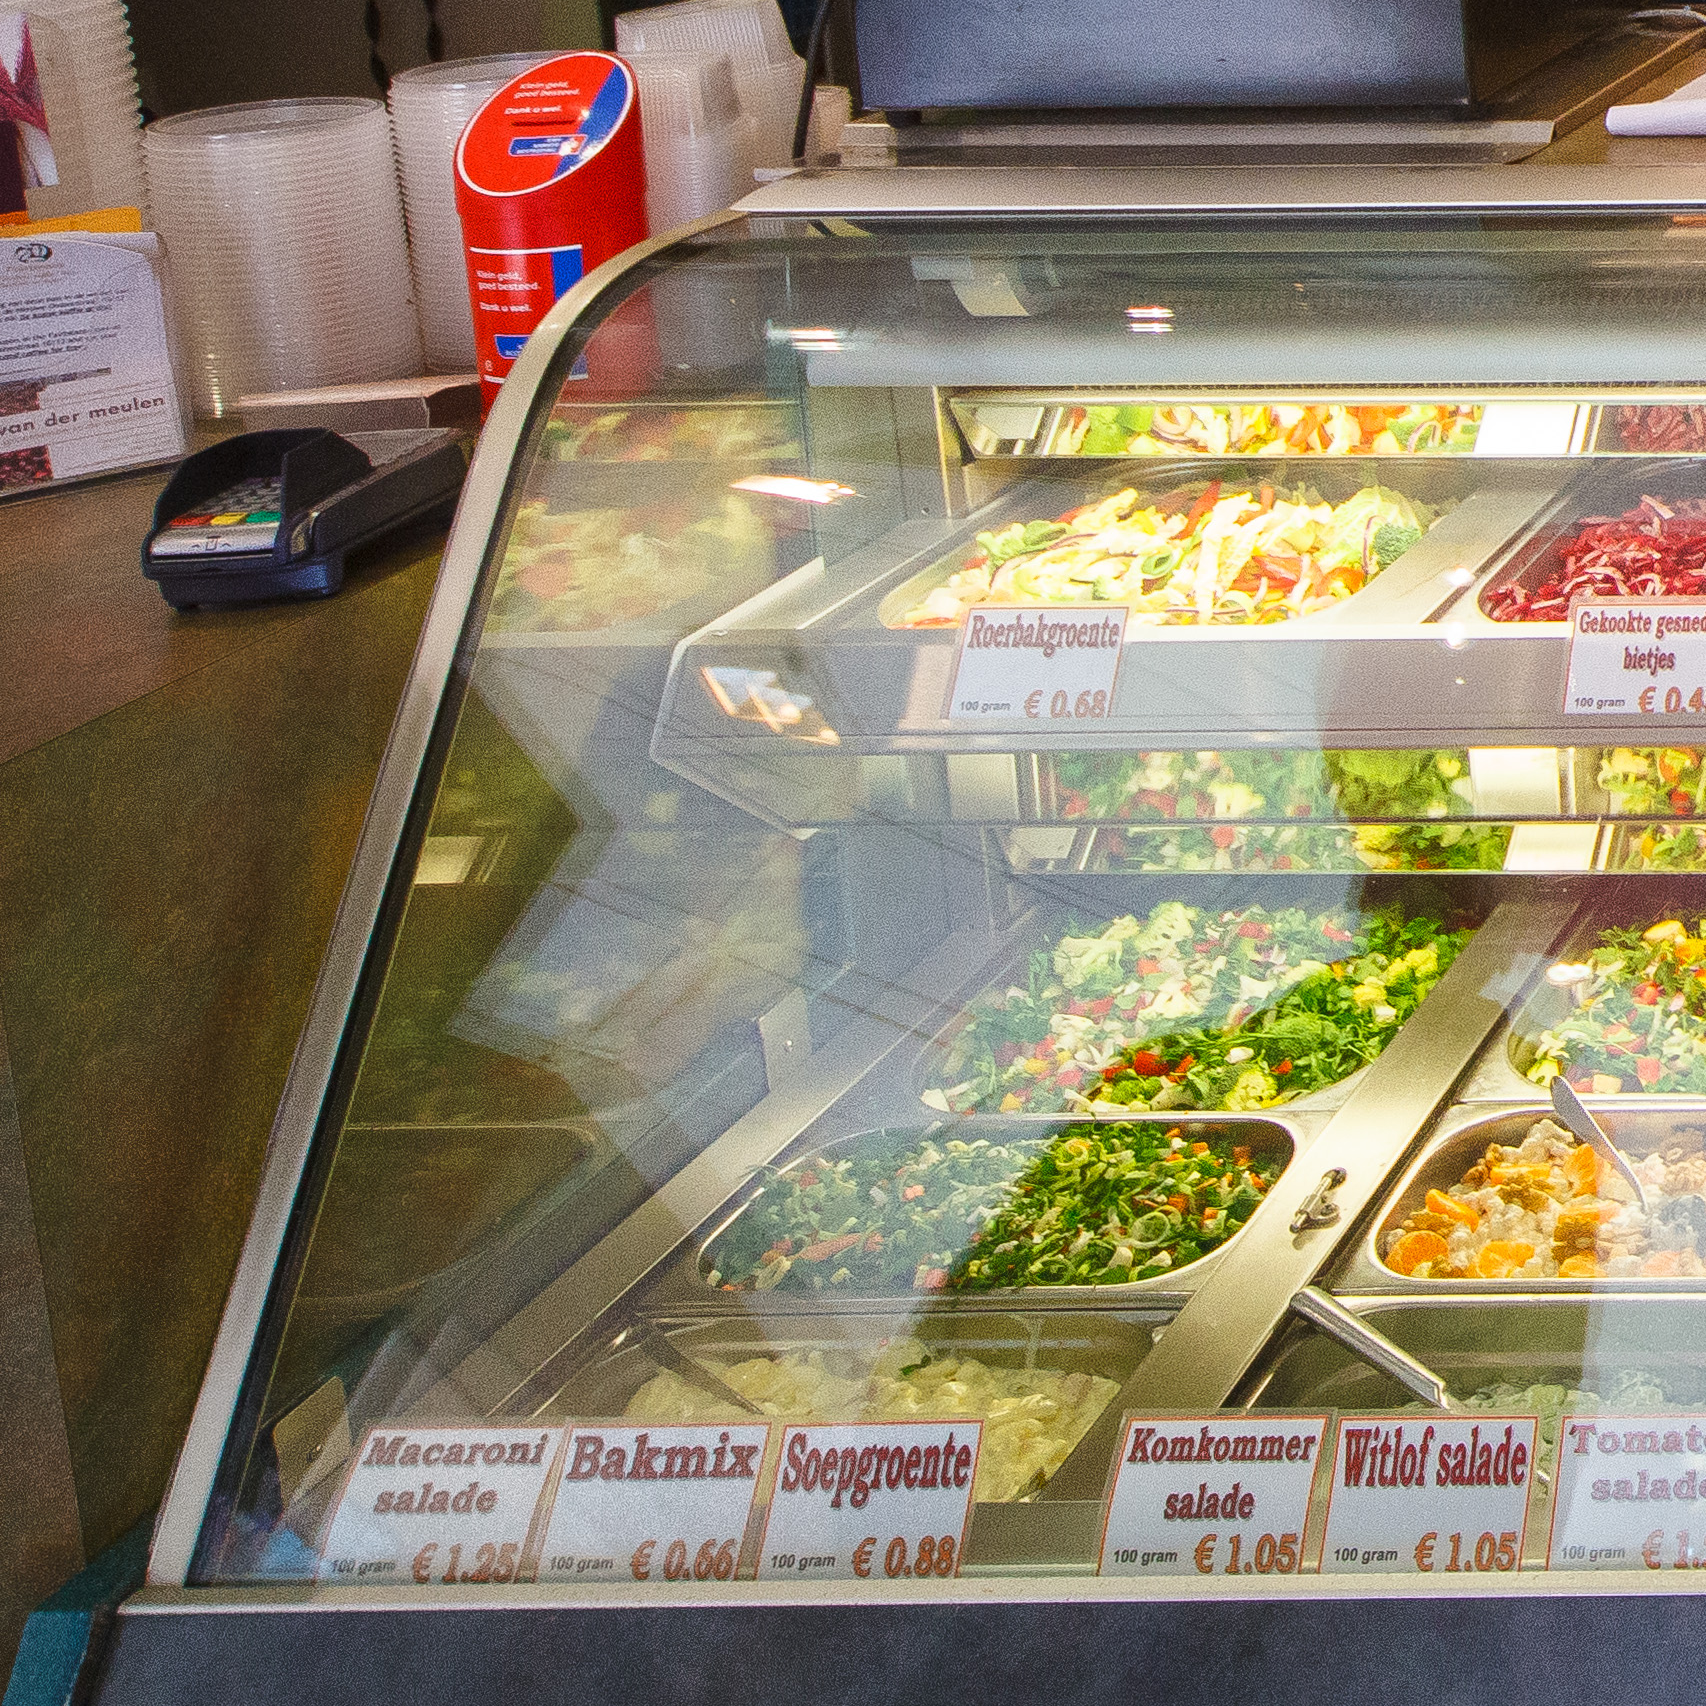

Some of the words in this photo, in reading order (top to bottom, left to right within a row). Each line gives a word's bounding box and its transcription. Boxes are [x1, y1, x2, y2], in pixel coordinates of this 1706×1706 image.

[44, 412, 80, 428] der
[89, 396, 165, 419] meulen
[966, 613, 1120, 658] Roerbakgroente
[1579, 609, 1652, 633] Gekookte
[1623, 646, 1676, 676] bietjes
[1050, 689, 1107, 719] 0.68
[362, 1435, 549, 1467] Macaroni
[566, 1434, 759, 1483] Bakmix
[1127, 1426, 1315, 1463] Komkommer
[1344, 1425, 1433, 1487] Witlof
[1436, 1424, 1527, 1486] salade
[782, 1431, 972, 1510] Soepgroente
[373, 1482, 498, 1516] salade
[1164, 1482, 1255, 1521] salade
[441, 1542, 519, 1583] 1.25
[663, 1539, 738, 1581] 0.66
[885, 1536, 957, 1580] 0.88
[1112, 1550, 1139, 1563] 100
[1141, 1551, 1178, 1566] gram
[1226, 1533, 1298, 1574] 1.05
[1445, 1531, 1517, 1571] 1.05
